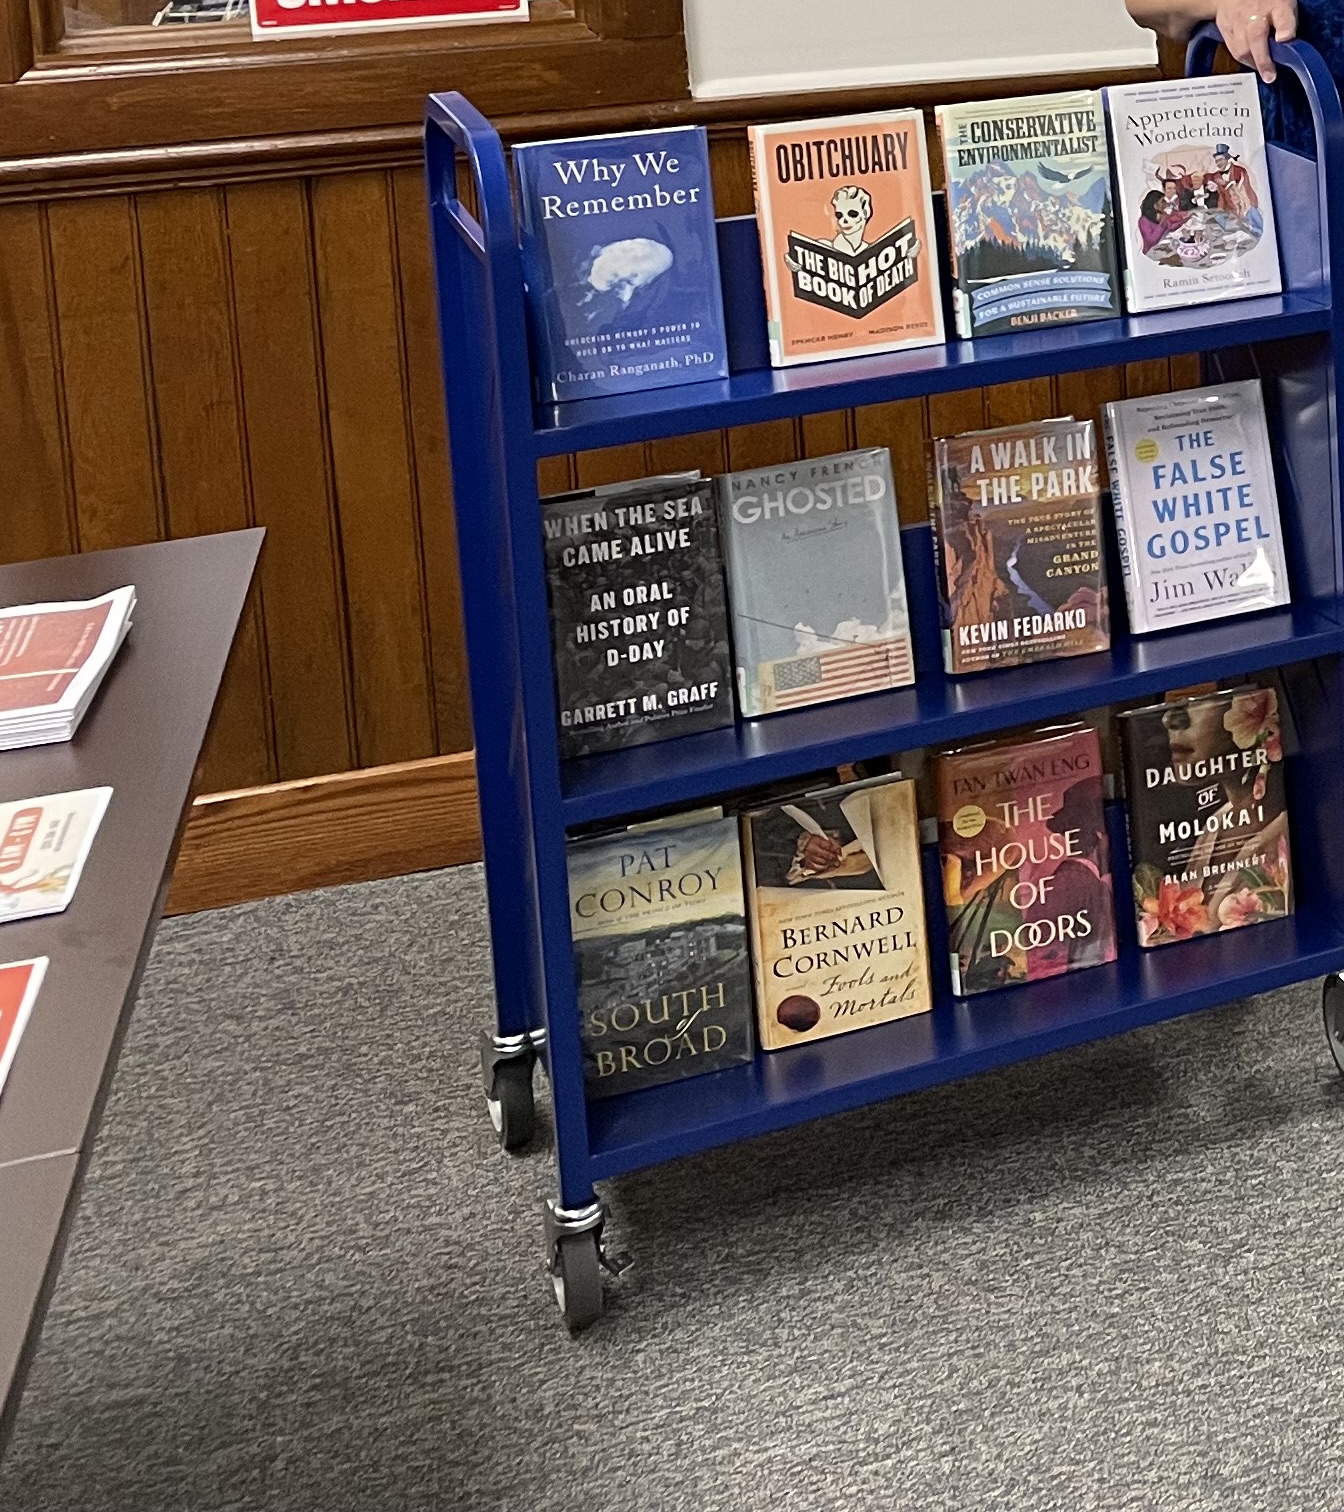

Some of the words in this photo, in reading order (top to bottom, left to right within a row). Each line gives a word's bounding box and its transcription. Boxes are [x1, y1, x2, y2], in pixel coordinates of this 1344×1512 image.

[970, 110, 1097, 144] CONSERVATIVE
[1125, 103, 1229, 131] Apprentice
[1233, 102, 1251, 118] in
[1134, 122, 1245, 147] Wonderland
[554, 158, 626, 188] Why
[632, 151, 680, 176] We
[776, 131, 909, 184] OBITCHUARY
[957, 135, 1099, 167] ENVIRONMENTALIST
[541, 185, 701, 221] Remember
[794, 245, 826, 277] THE
[827, 256, 856, 288] BIG
[858, 232, 913, 287] HOT
[798, 270, 858, 310] BOOK
[859, 281, 875, 308] OF
[876, 257, 914, 298] DEATH
[556, 368, 606, 384] Charan
[685, 351, 715, 367] PhD
[971, 445, 986, 474] A
[991, 436, 1057, 471] WALK
[1067, 432, 1092, 462] IN
[1175, 430, 1215, 451] THE
[732, 470, 799, 492] NANCY
[976, 474, 1022, 507] THE
[1031, 464, 1094, 500] PARK
[1152, 451, 1246, 489] FALSE
[544, 511, 608, 540] WHEN
[617, 500, 656, 529] THE
[663, 495, 703, 520] SEA
[731, 475, 887, 525] GHOSTED
[1152, 483, 1253, 523] WHITE
[562, 537, 624, 568] CAME
[629, 527, 692, 557] ALIVE
[1053, 550, 1098, 564] GRAND
[1147, 516, 1270, 560] GOSPEL
[1046, 561, 1099, 578] CANYON
[589, 590, 616, 613] AN
[622, 581, 674, 605] ORAL
[1150, 578, 1194, 603] Jim
[576, 610, 660, 644] HISTORY
[667, 606, 691, 628] OF
[960, 620, 1008, 646] KEVIN
[1013, 608, 1086, 638] FEDARKO
[606, 639, 666, 667] D-DAY
[561, 696, 637, 727] GARRETT
[667, 681, 719, 707] GRAFF
[1050, 752, 1090, 780] ENG
[1145, 747, 1269, 789] DAUGHTER
[996, 793, 1055, 829] THE
[618, 844, 677, 878] PAT
[975, 828, 1083, 876] HOUSE
[574, 866, 723, 919] CONROY
[1009, 875, 1055, 910] OF
[1164, 869, 1198, 886] ALAN
[781, 906, 905, 950] BERNARD
[989, 909, 1092, 958] DOORS
[772, 930, 918, 980] CORNWELL
[820, 966, 876, 997] Fools
[588, 982, 727, 1038] SOUTH
[829, 986, 918, 1020] Mortals
[593, 1024, 728, 1078] BROAD
